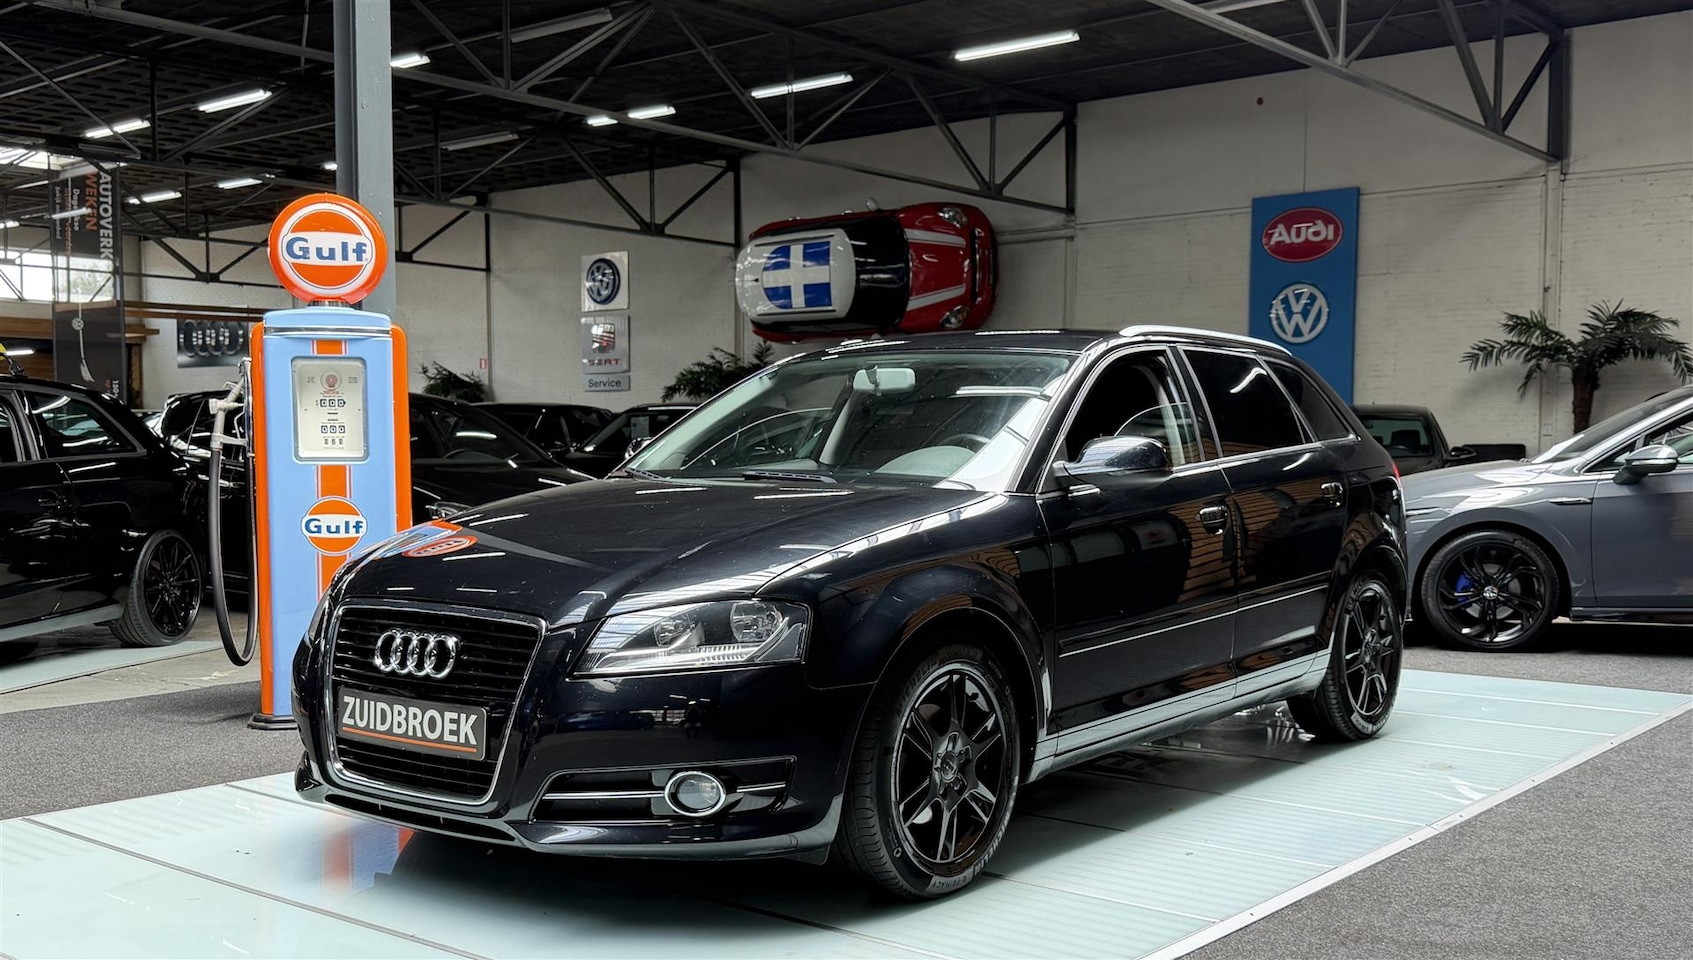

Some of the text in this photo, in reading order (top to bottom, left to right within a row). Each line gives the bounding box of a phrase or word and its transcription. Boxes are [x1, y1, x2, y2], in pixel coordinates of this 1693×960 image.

[72, 188, 80, 231] Dagekse
[285, 236, 367, 262] Gulf
[588, 378, 622, 388] Service
[304, 518, 364, 534] Gulf
[342, 695, 478, 745] ZUIDBROEK
